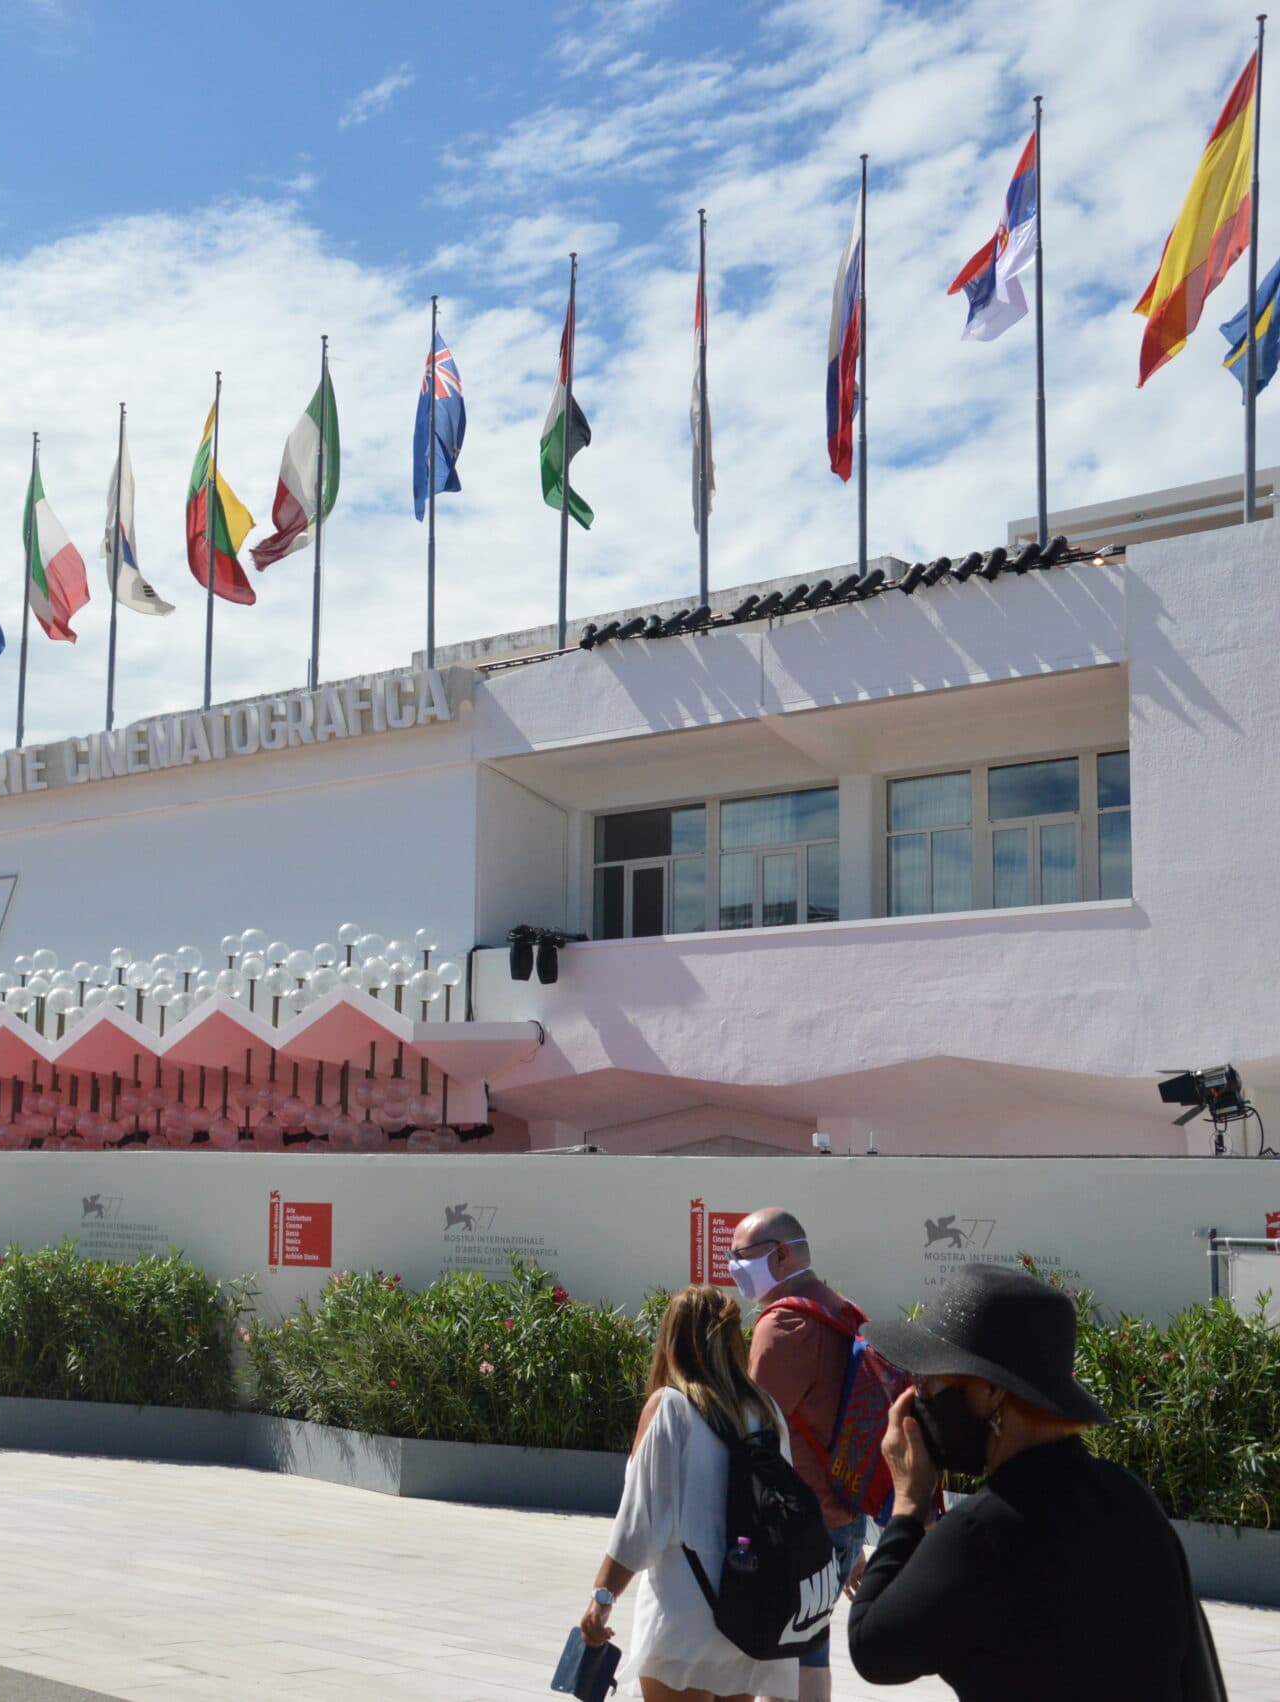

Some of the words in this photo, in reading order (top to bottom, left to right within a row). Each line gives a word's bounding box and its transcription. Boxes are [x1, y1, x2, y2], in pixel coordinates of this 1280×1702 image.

[64, 668, 455, 784] CINEMATOGRAFICA
[924, 1252, 966, 1262] MOSTRA
[795, 1546, 841, 1625] NIK
